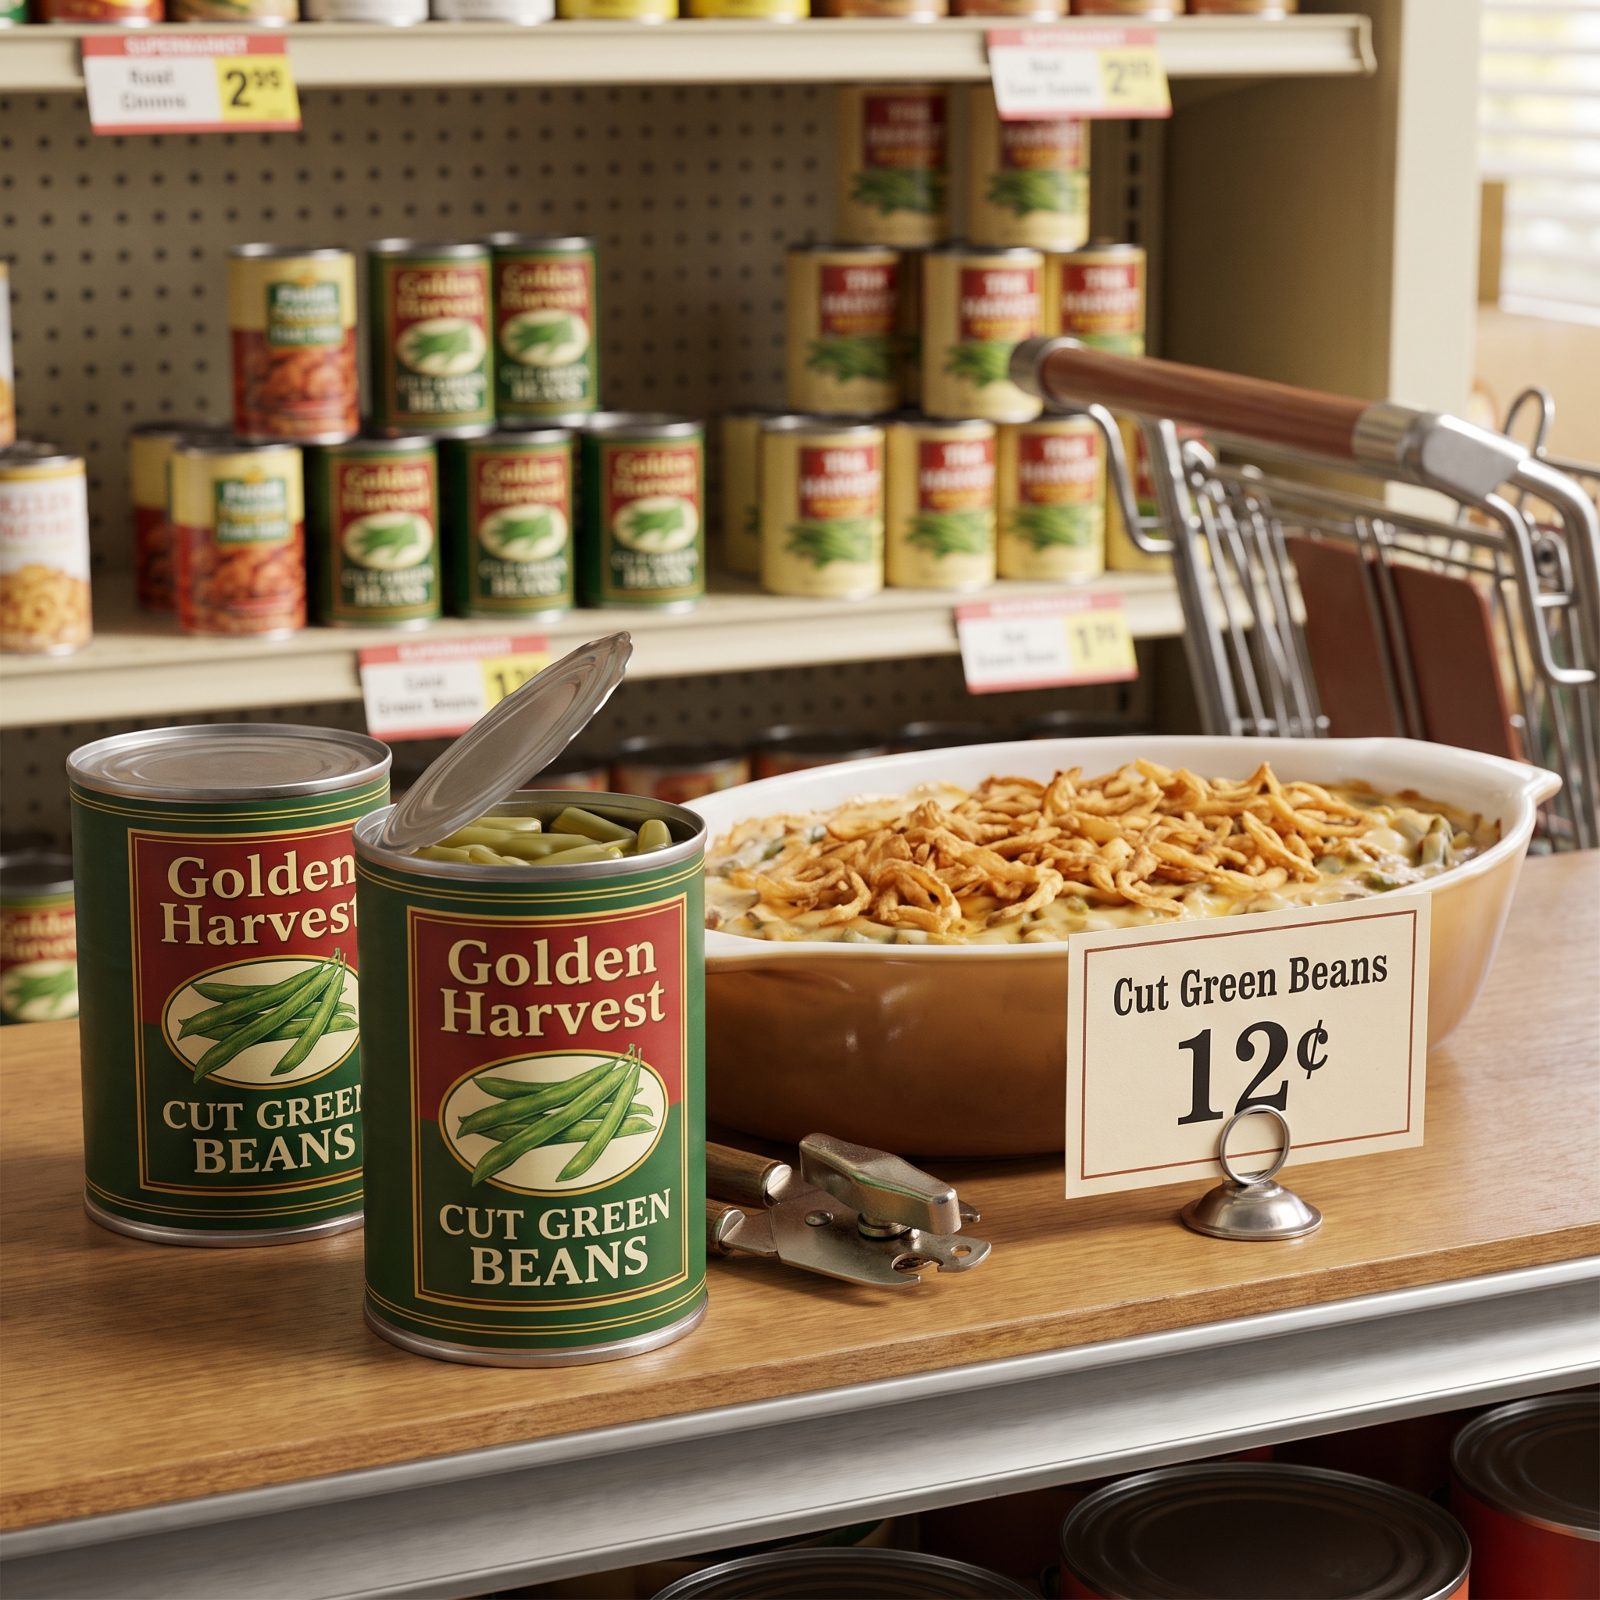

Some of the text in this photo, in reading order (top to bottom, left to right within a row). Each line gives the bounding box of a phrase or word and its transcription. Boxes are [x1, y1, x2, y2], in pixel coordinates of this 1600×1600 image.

[168, 850, 356, 899] Golden
[448, 935, 657, 987] Golden
[1113, 954, 1388, 1016] Cut Green Beans
[440, 980, 666, 1037] Harvest
[1177, 1019, 1329, 1126] 12¢
[162, 1100, 243, 1131] CUT
[193, 1123, 356, 1174] BEANS
[439, 1188, 671, 1240] CUT GREEN
[470, 1235, 649, 1287] BEANS
